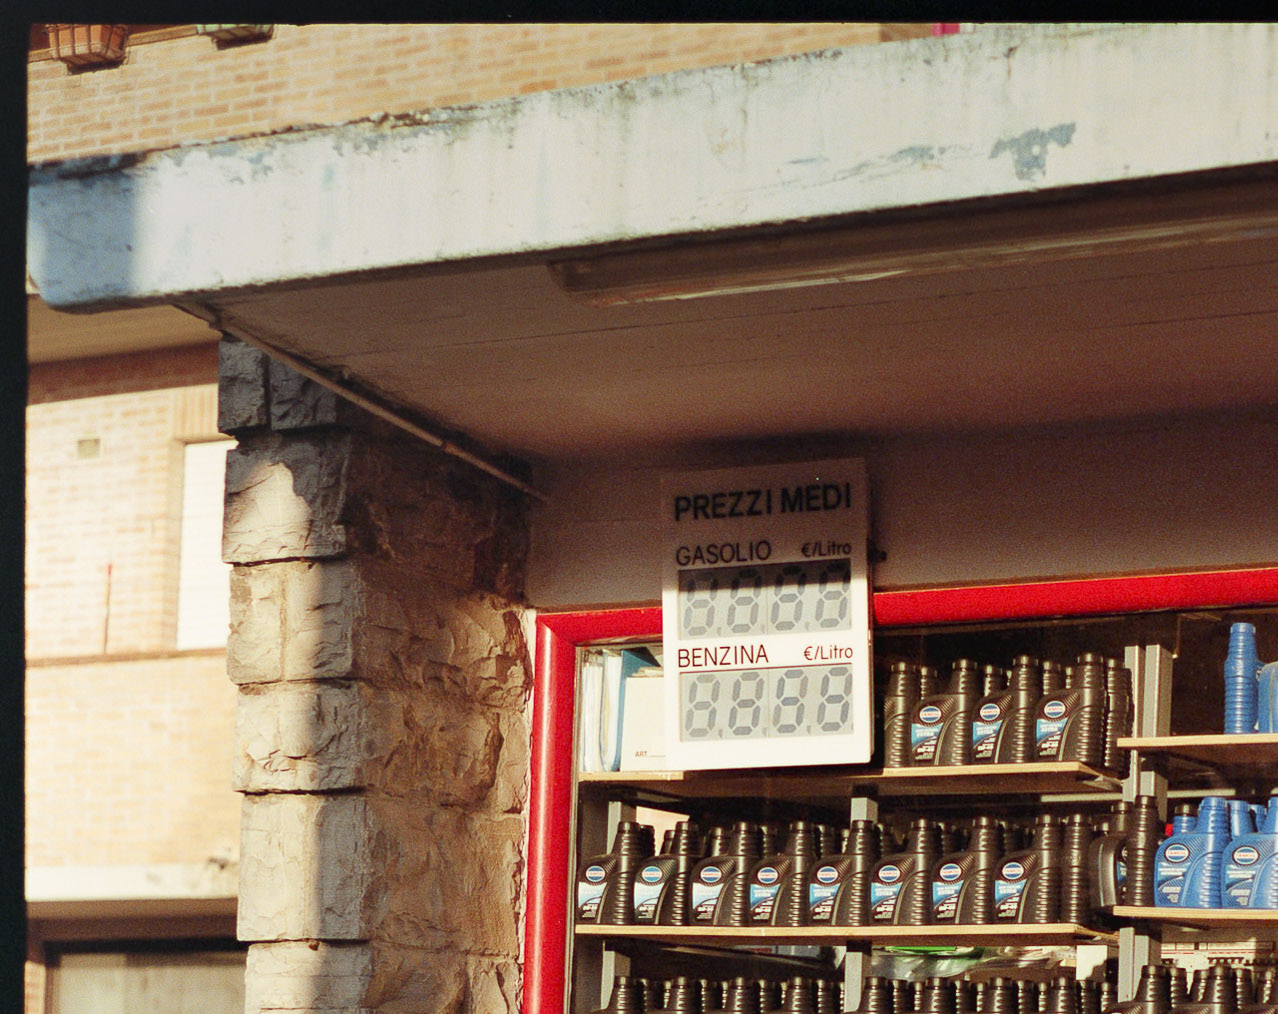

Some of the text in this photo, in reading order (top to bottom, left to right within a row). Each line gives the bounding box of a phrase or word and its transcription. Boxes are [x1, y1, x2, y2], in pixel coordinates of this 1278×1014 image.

[674, 482, 851, 521] PREZZI MEDI
[676, 540, 852, 566] GASOLIO €/Litro
[678, 644, 854, 668] BENZINA €/Litro
